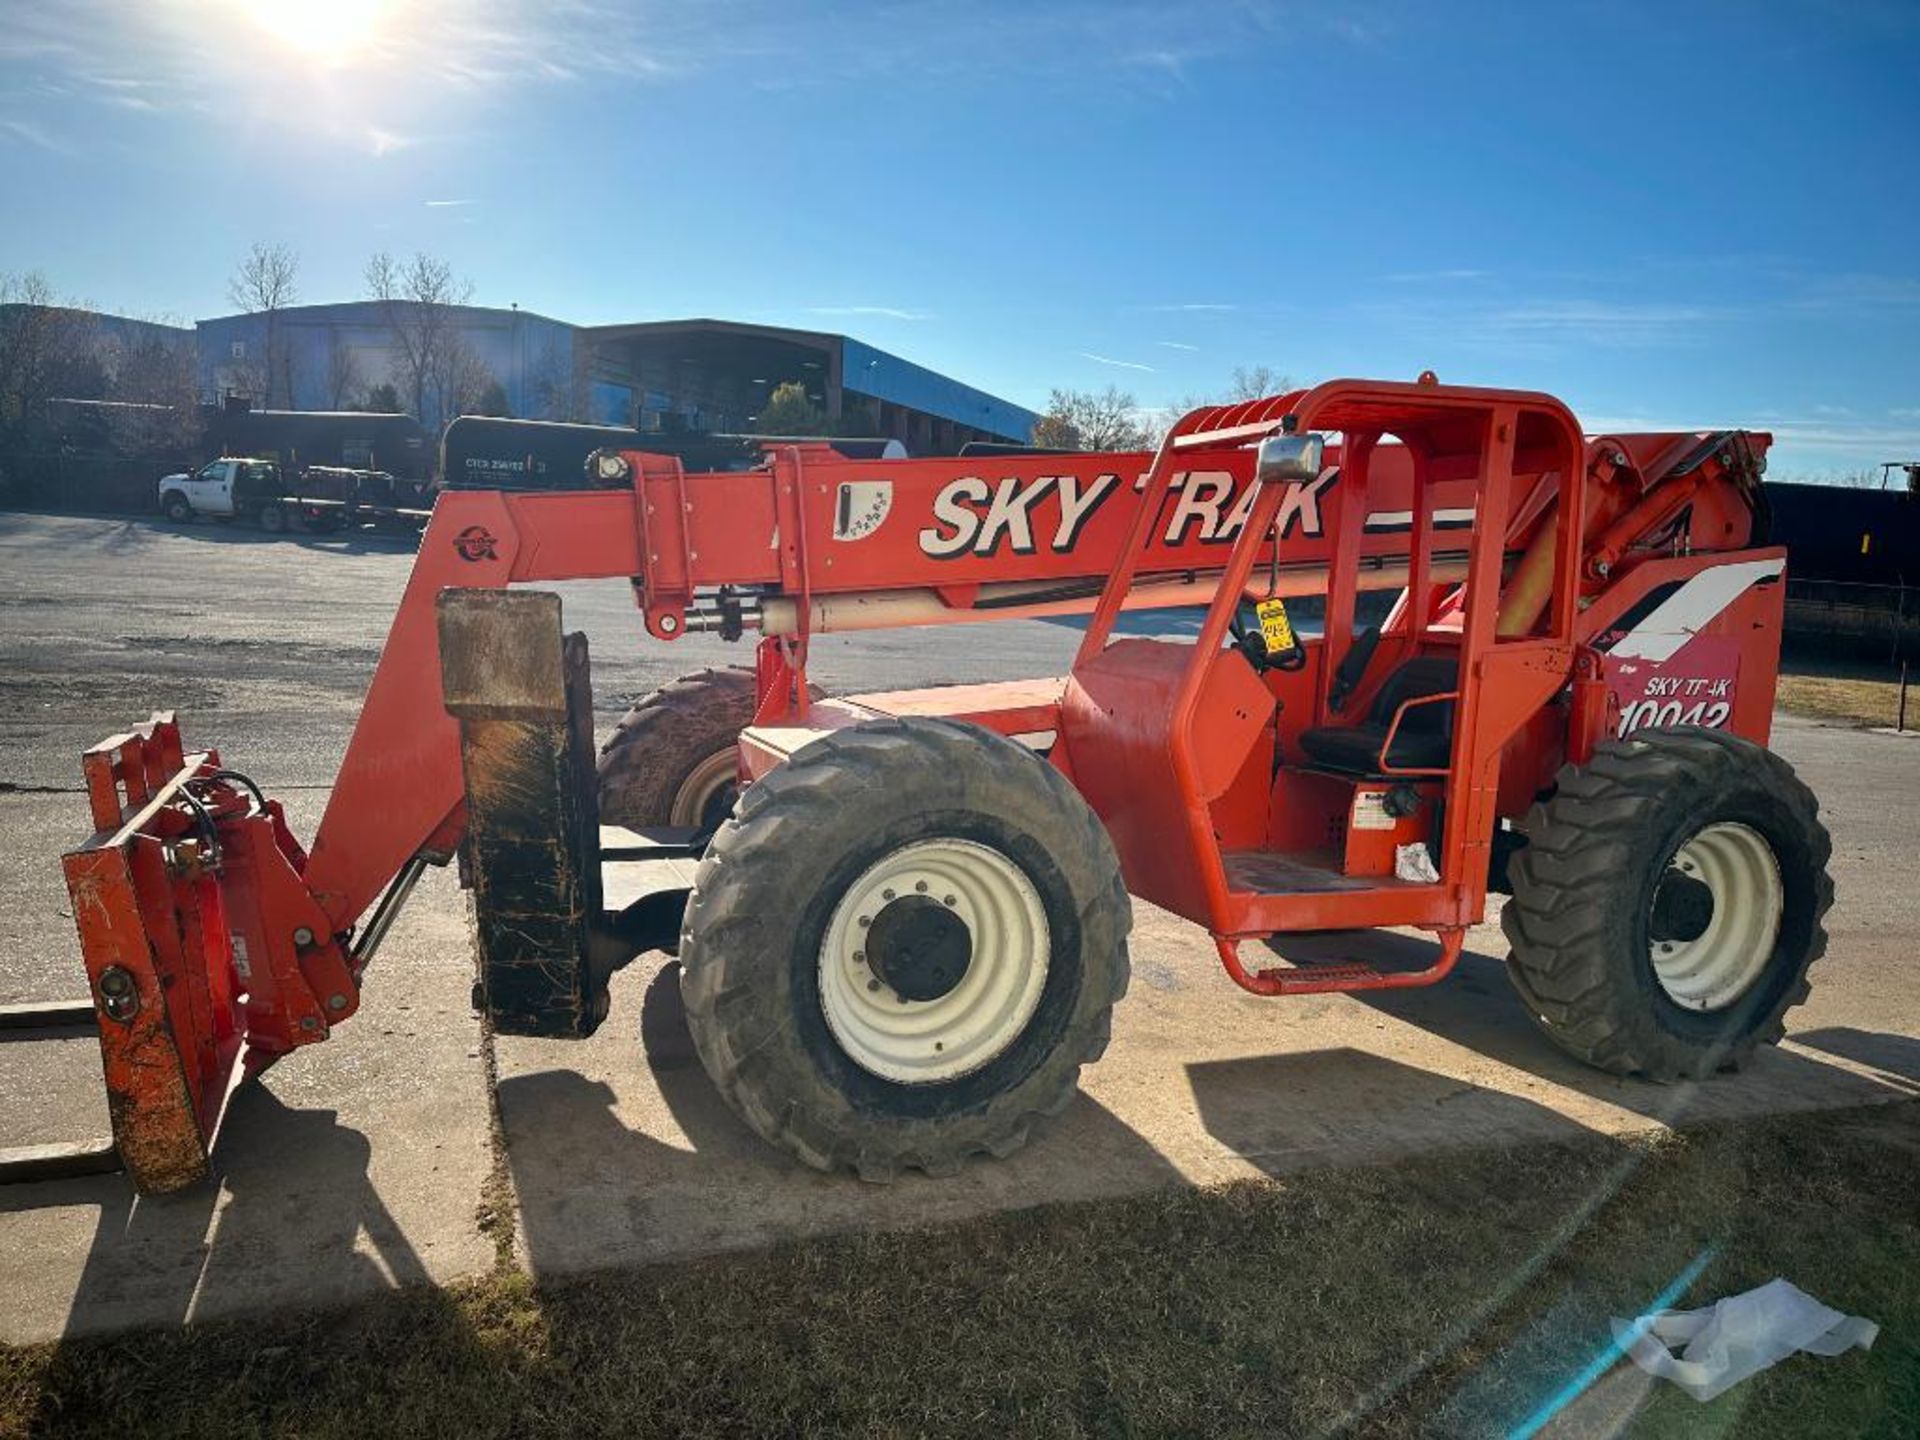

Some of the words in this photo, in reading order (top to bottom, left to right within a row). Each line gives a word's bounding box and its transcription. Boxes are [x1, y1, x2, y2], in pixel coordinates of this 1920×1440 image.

[918, 474, 1121, 559] SKY
[1644, 677, 1684, 696] SKY
[1618, 700, 1731, 740] 10042
